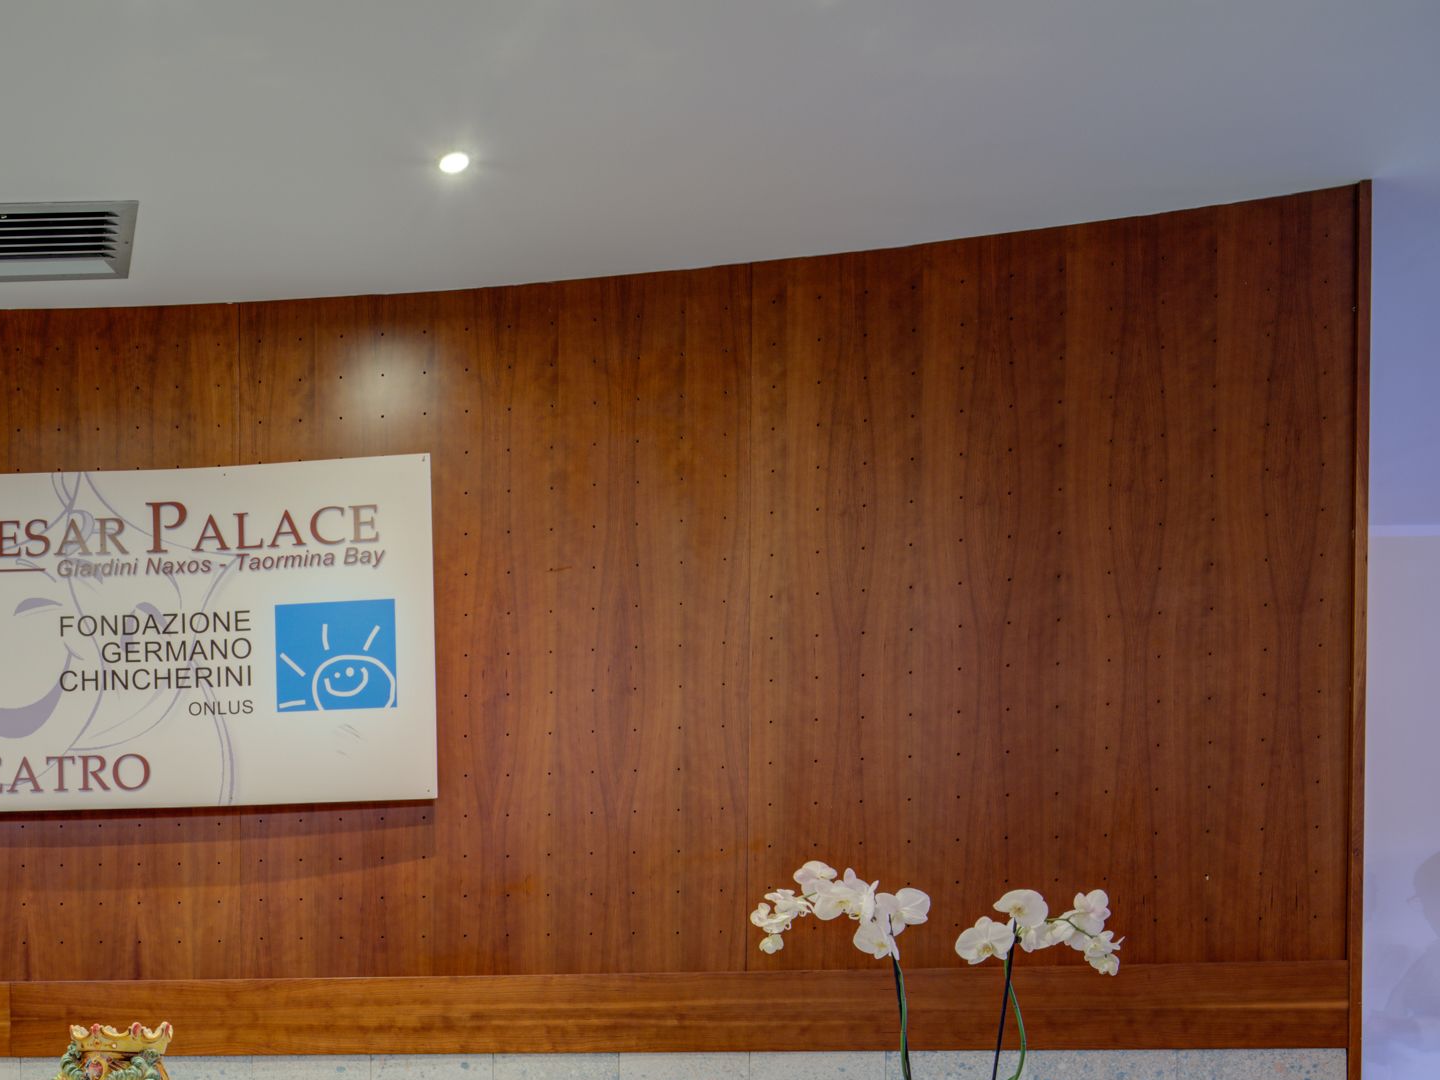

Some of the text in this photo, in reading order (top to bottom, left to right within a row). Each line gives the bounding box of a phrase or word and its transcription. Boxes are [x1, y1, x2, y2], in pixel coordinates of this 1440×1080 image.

[145, 500, 380, 554] PALACE
[56, 558, 139, 578] Giardini
[145, 557, 212, 576] Naxos
[236, 549, 335, 572] Taormina
[343, 547, 385, 569] Bay
[60, 610, 252, 637] FONDAZIONE
[101, 637, 252, 663] GERMANO
[60, 665, 252, 692] CHINCHERINI
[188, 700, 254, 716] ONLUS
